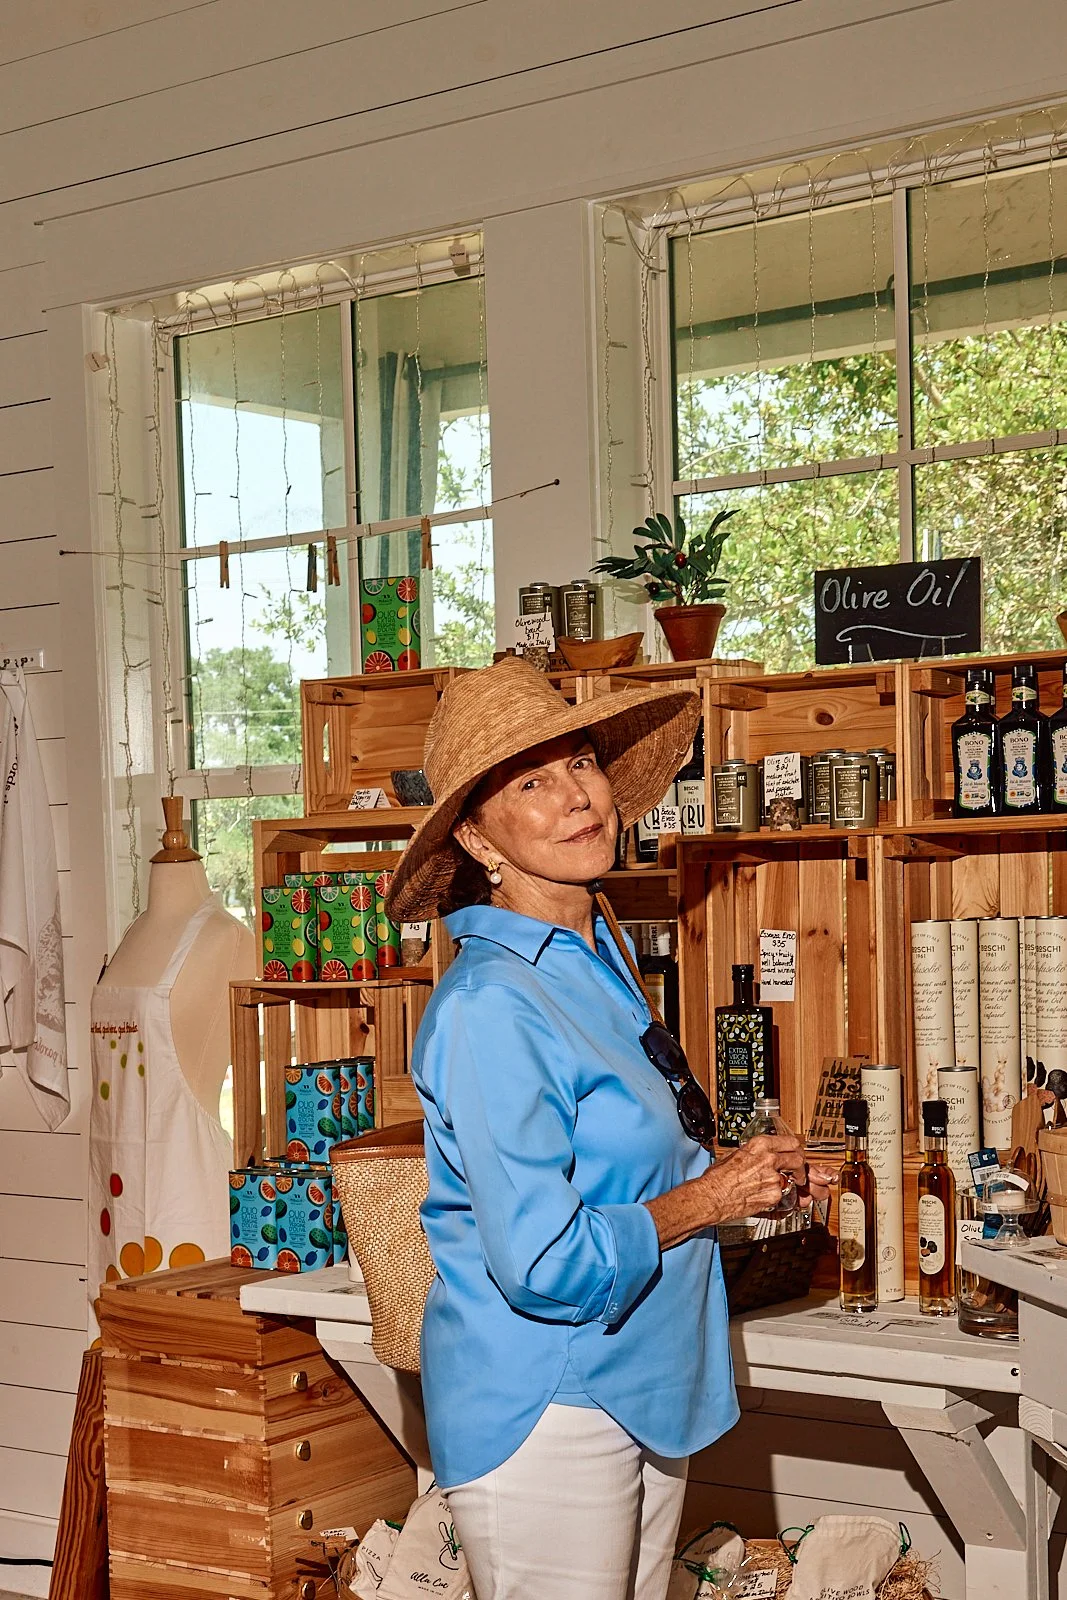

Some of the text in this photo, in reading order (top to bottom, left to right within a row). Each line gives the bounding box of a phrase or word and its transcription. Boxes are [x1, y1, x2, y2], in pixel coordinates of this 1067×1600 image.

[820, 560, 971, 613] Olive Oil
[526, 633, 540, 641] $17
[766, 754, 794, 765] Olive Oil
[5, 762, 19, 791] ords
[643, 806, 661, 830] CR
[952, 944, 965, 953] CHI
[826, 1100, 844, 1109] OLIV
[361, 1545, 381, 1561] PIZZA
